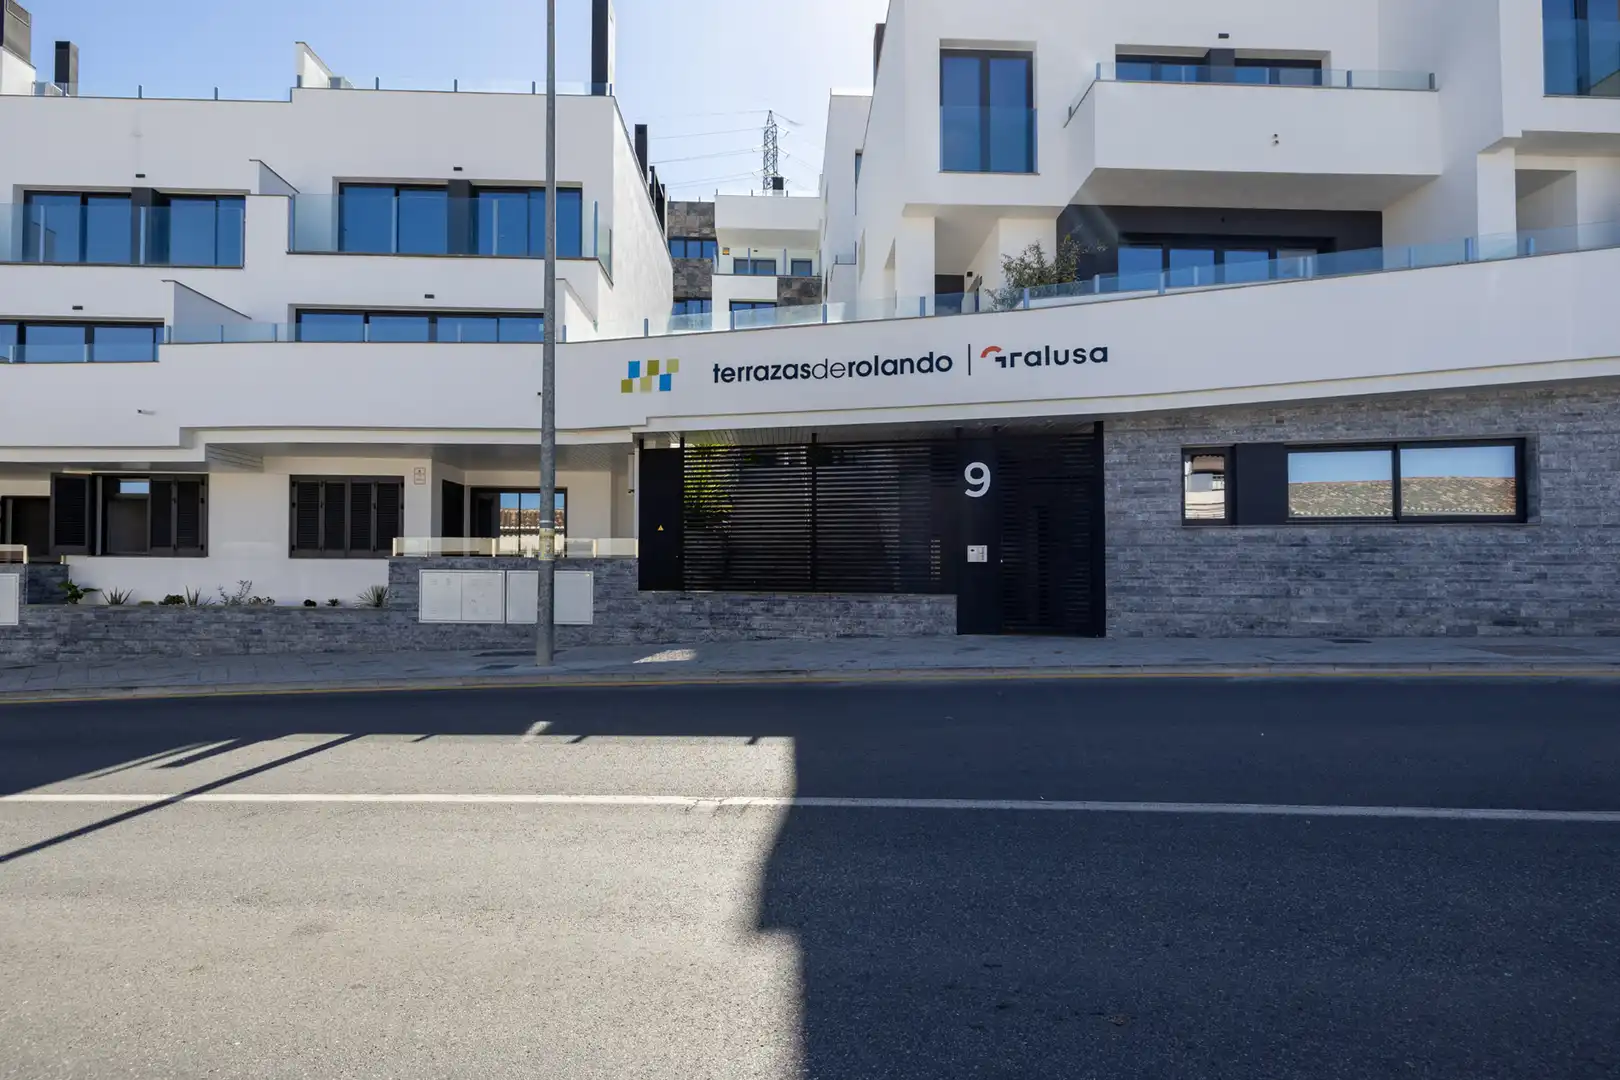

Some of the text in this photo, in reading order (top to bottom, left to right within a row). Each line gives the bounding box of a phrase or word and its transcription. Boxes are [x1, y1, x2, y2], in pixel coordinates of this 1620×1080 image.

[713, 345, 1108, 384] terrazasderolando Gralusa
[964, 461, 991, 498] 9
